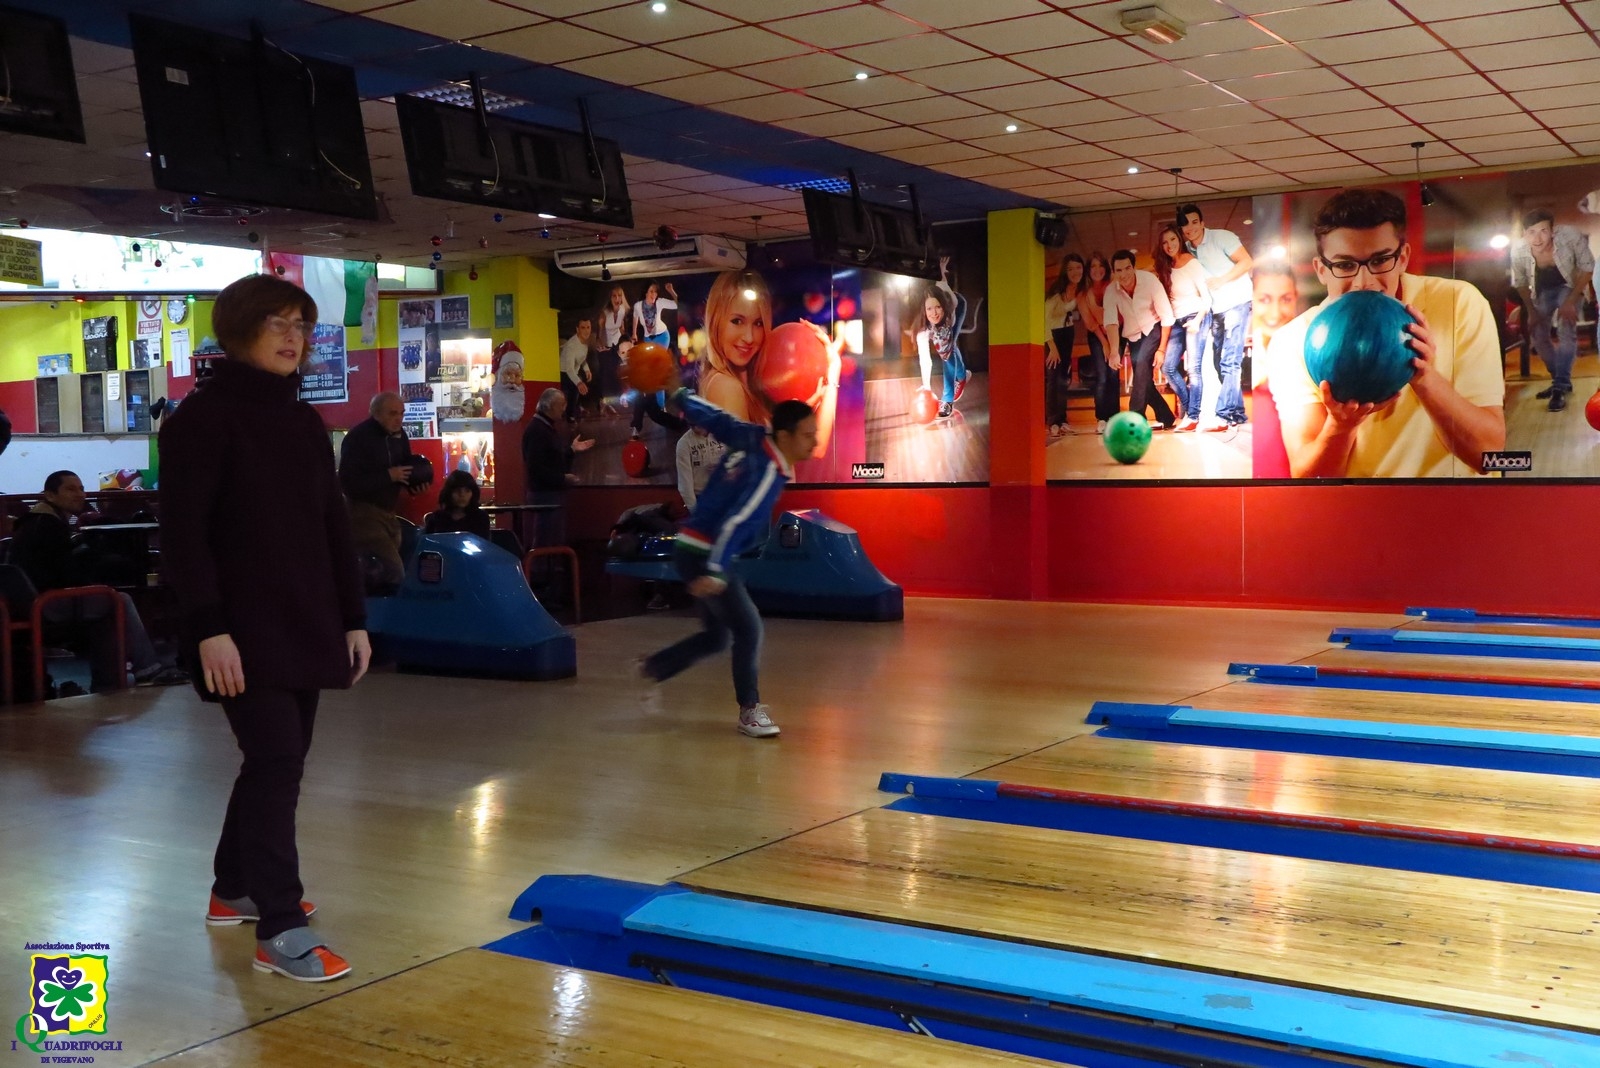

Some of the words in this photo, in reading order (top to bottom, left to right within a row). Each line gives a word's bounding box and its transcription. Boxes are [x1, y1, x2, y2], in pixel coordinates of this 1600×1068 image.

[3, 270, 38, 280] BOWLING
[437, 366, 458, 375] ITALIA
[1482, 453, 1531, 468] Macau
[852, 464, 884, 477] Macau
